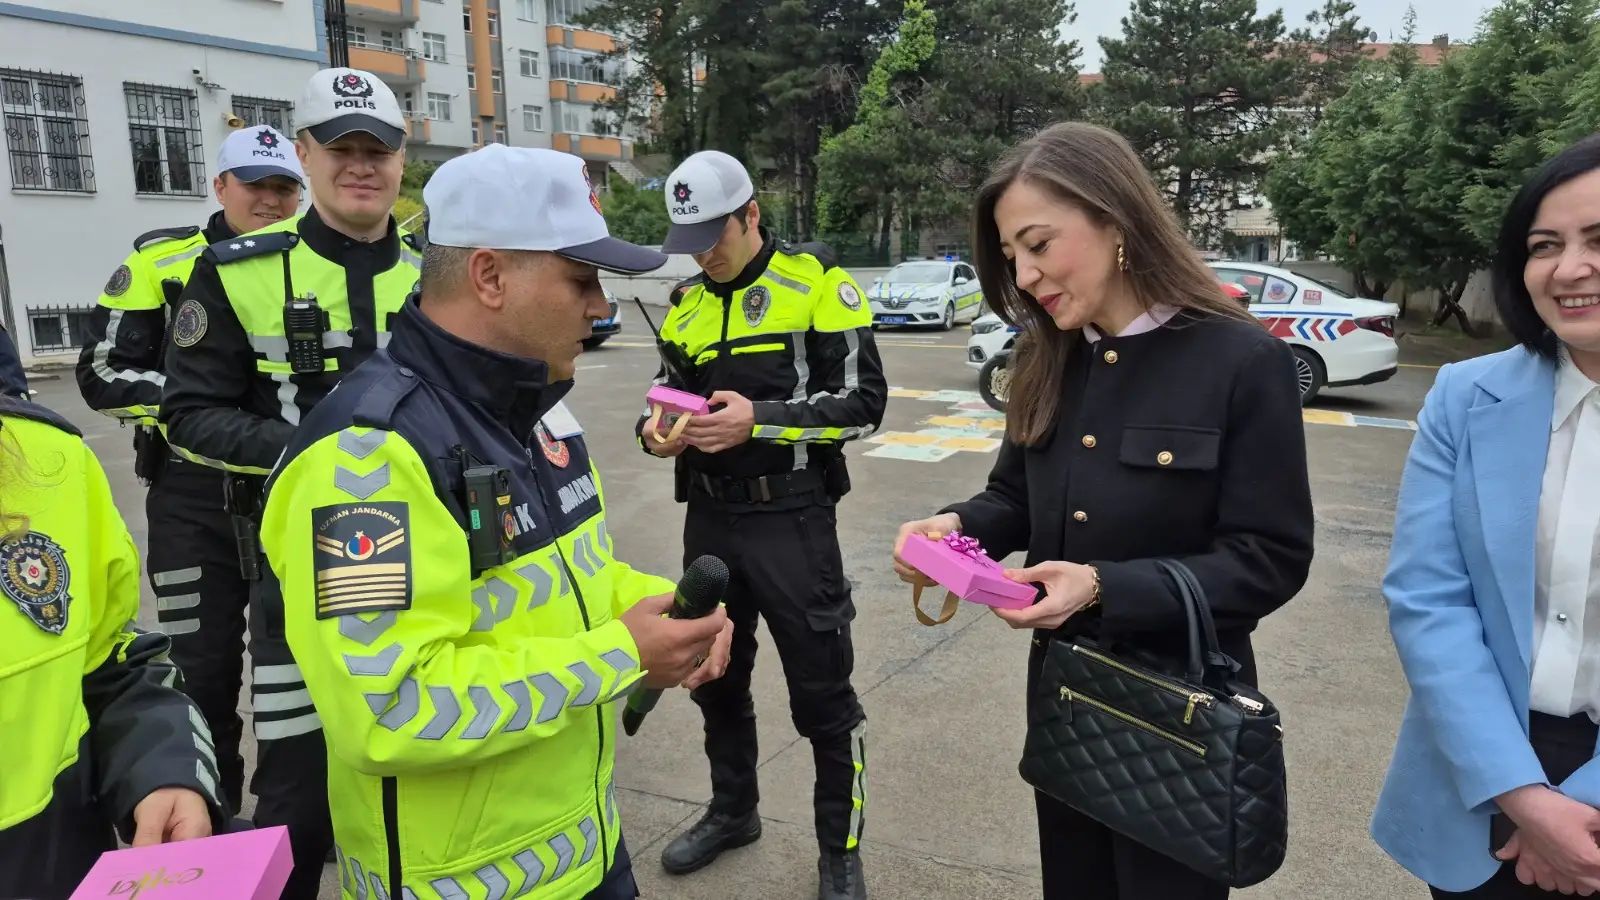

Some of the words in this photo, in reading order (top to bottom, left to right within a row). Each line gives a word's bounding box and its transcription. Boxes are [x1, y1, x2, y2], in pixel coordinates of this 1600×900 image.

[334, 98, 376, 110] POLİS
[1306, 291, 1320, 300] 112
[320, 509, 350, 531] UZMAN
[352, 507, 401, 526] JANDARMA
